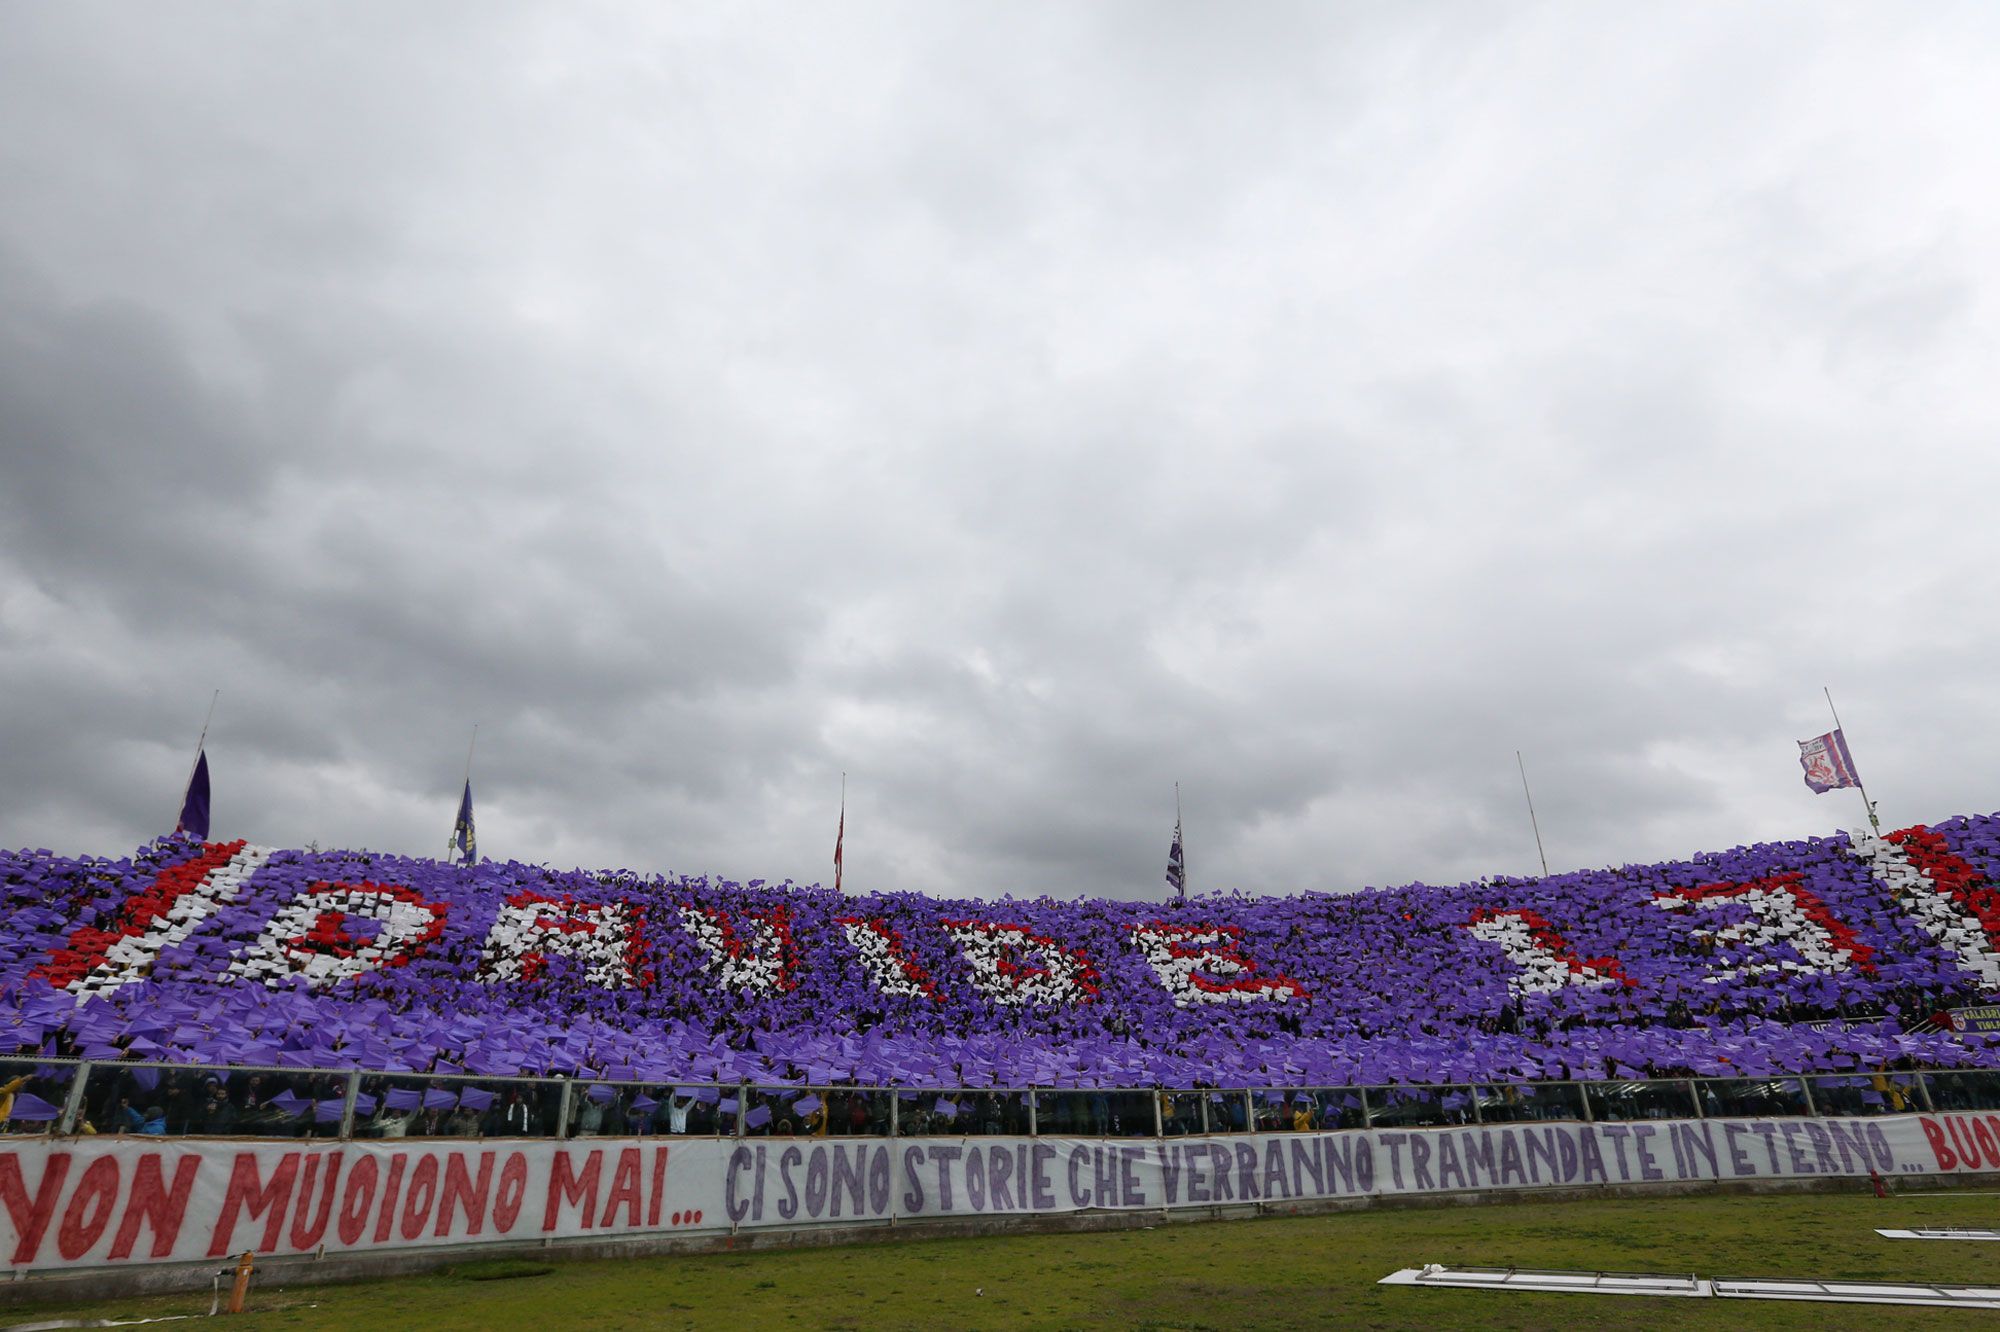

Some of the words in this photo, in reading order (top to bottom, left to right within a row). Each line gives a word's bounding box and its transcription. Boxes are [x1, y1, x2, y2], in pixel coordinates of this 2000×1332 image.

[206, 1151, 528, 1257] MUOIONO
[542, 1147, 703, 1232] MAI...
[778, 1144, 890, 1220] SONO
[903, 1143, 1057, 1214] STORIE
[1068, 1144, 1146, 1208] CHE
[1157, 1136, 1374, 1205] VERRANNO
[1379, 1122, 1664, 1190] TRAMANDATE
[1669, 1121, 1720, 1180] IN
